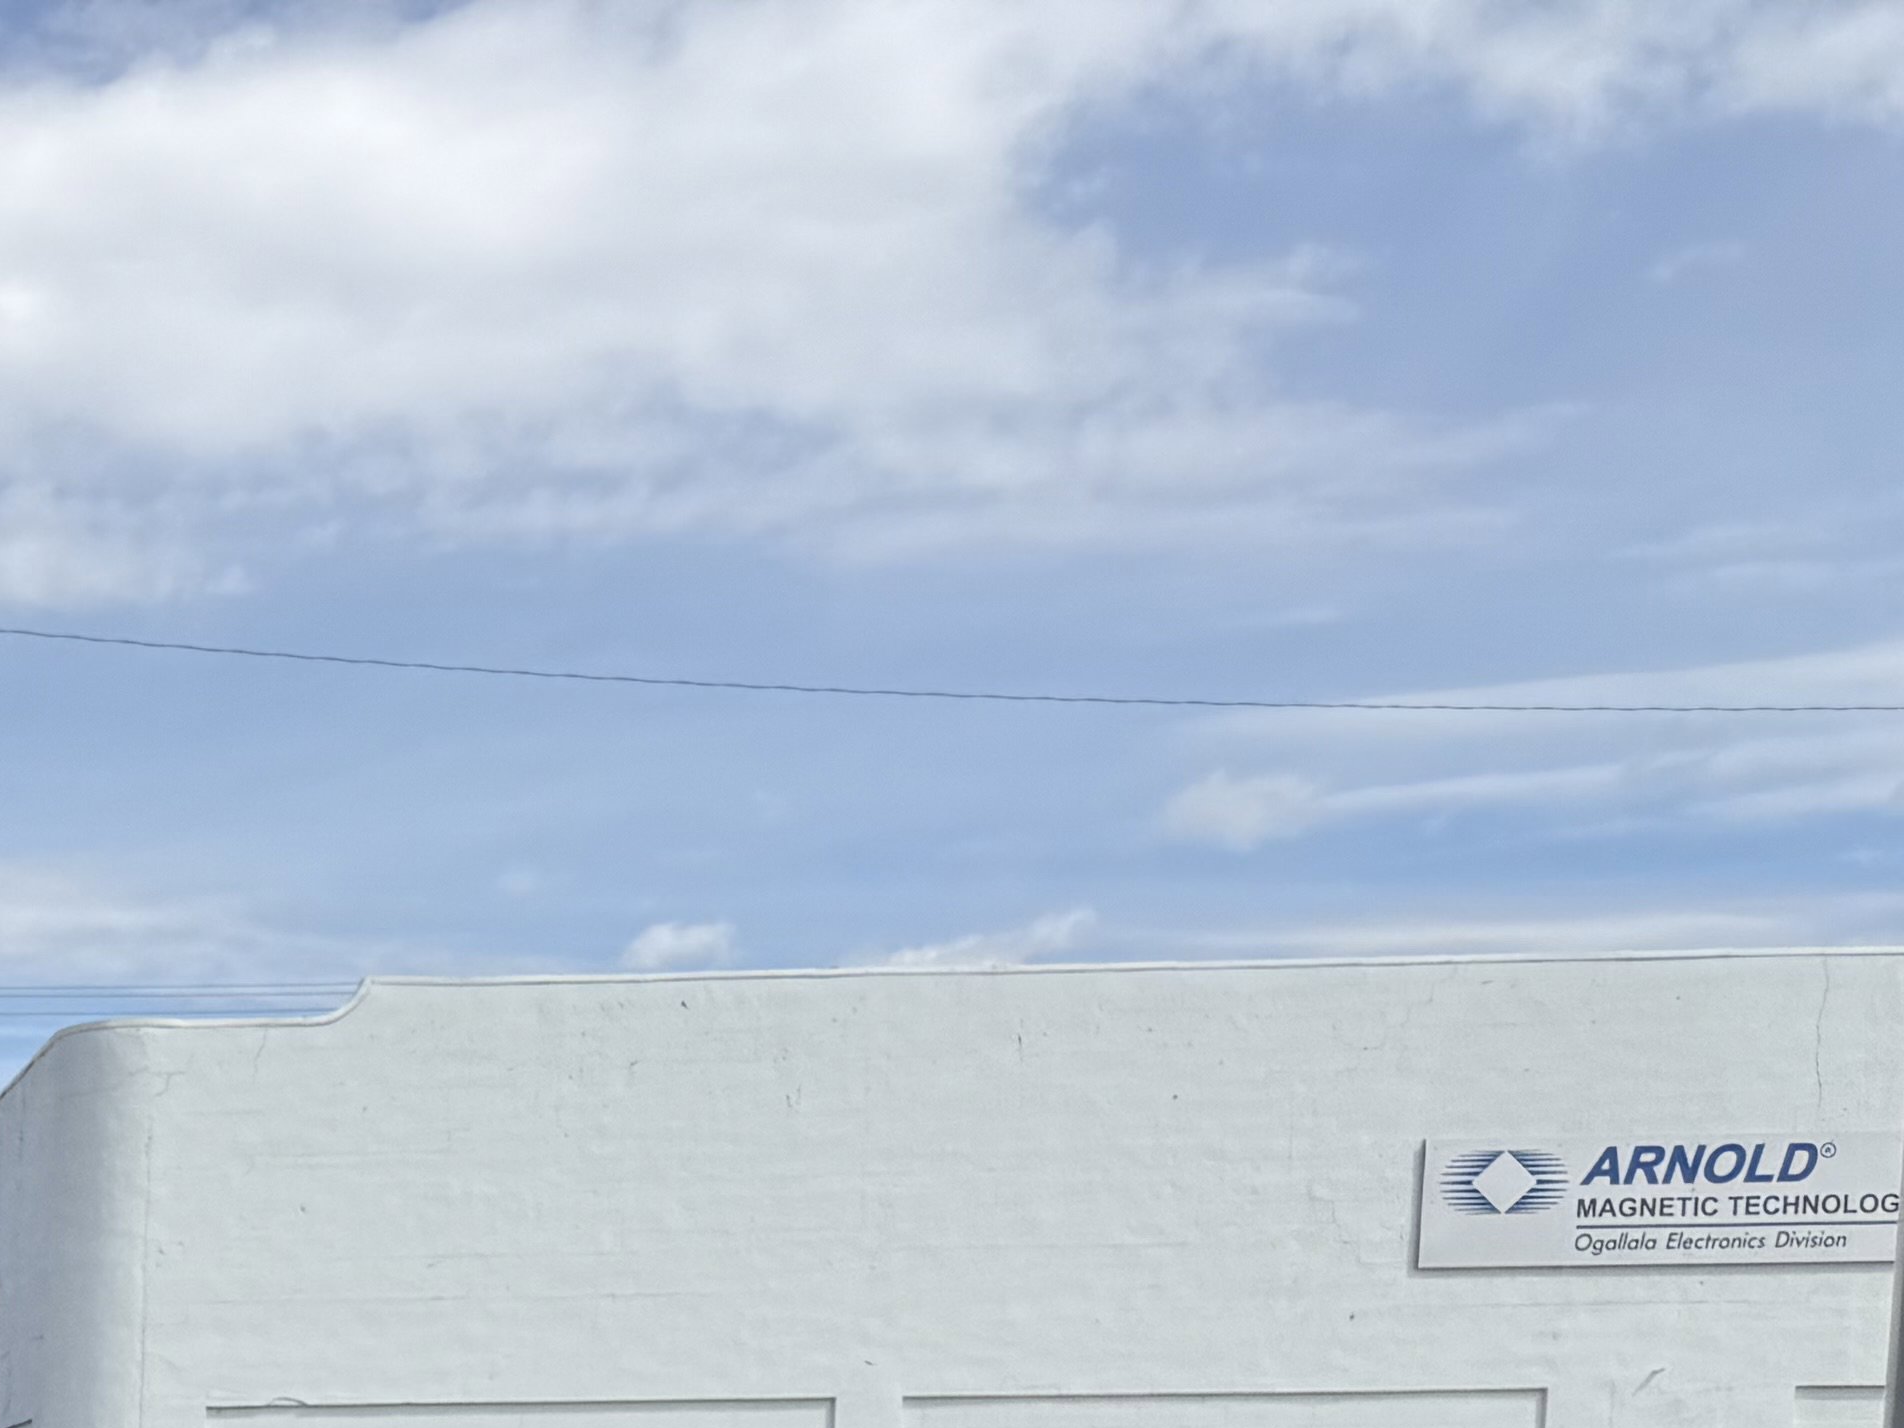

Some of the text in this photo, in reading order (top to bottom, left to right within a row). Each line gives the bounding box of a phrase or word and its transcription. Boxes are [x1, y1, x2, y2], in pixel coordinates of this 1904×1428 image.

[1576, 1193, 1900, 1218] MAGNETIC TECHNOLOG
[1574, 1230, 1848, 1255] Ogallala Electronics Division
